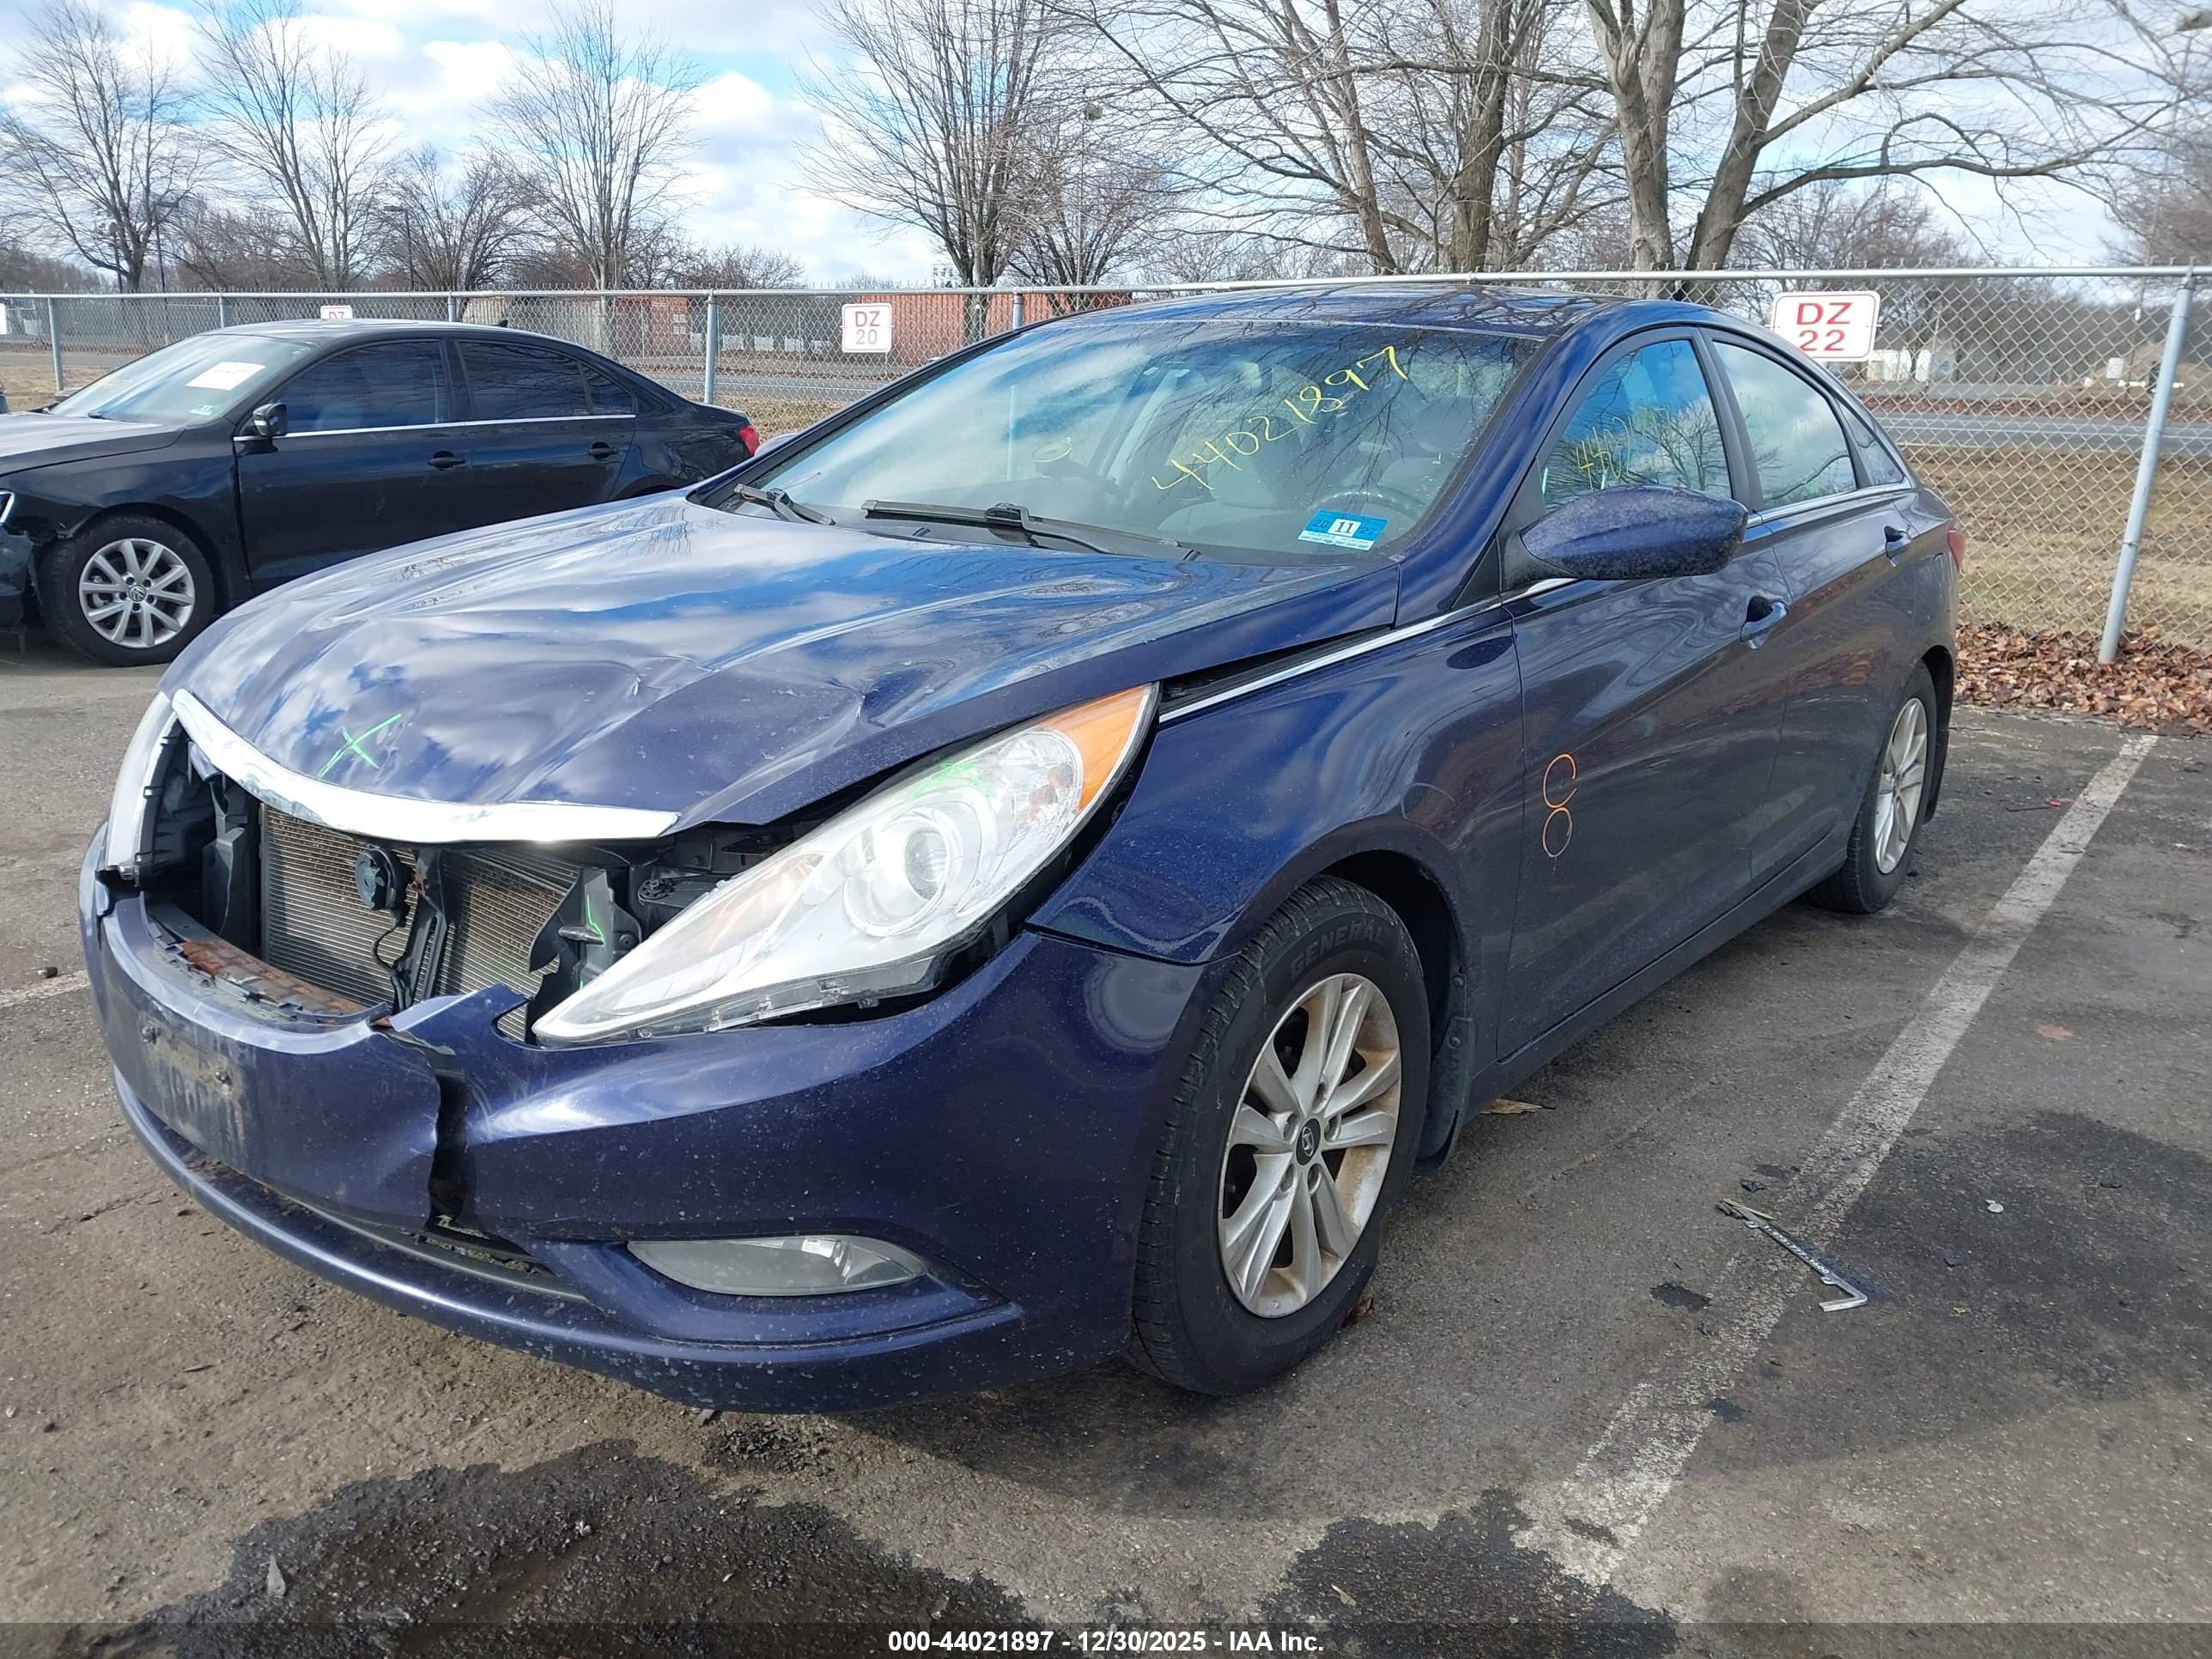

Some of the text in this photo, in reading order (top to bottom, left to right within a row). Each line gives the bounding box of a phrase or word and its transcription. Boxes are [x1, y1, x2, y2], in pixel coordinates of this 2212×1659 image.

[854, 310, 880, 328] DZ
[1796, 301, 1852, 325] DZ
[855, 328, 878, 345] 20
[1799, 329, 1845, 351] 22
[1151, 345, 1408, 490] 44021897
[1290, 919, 1385, 977] GENERAL
